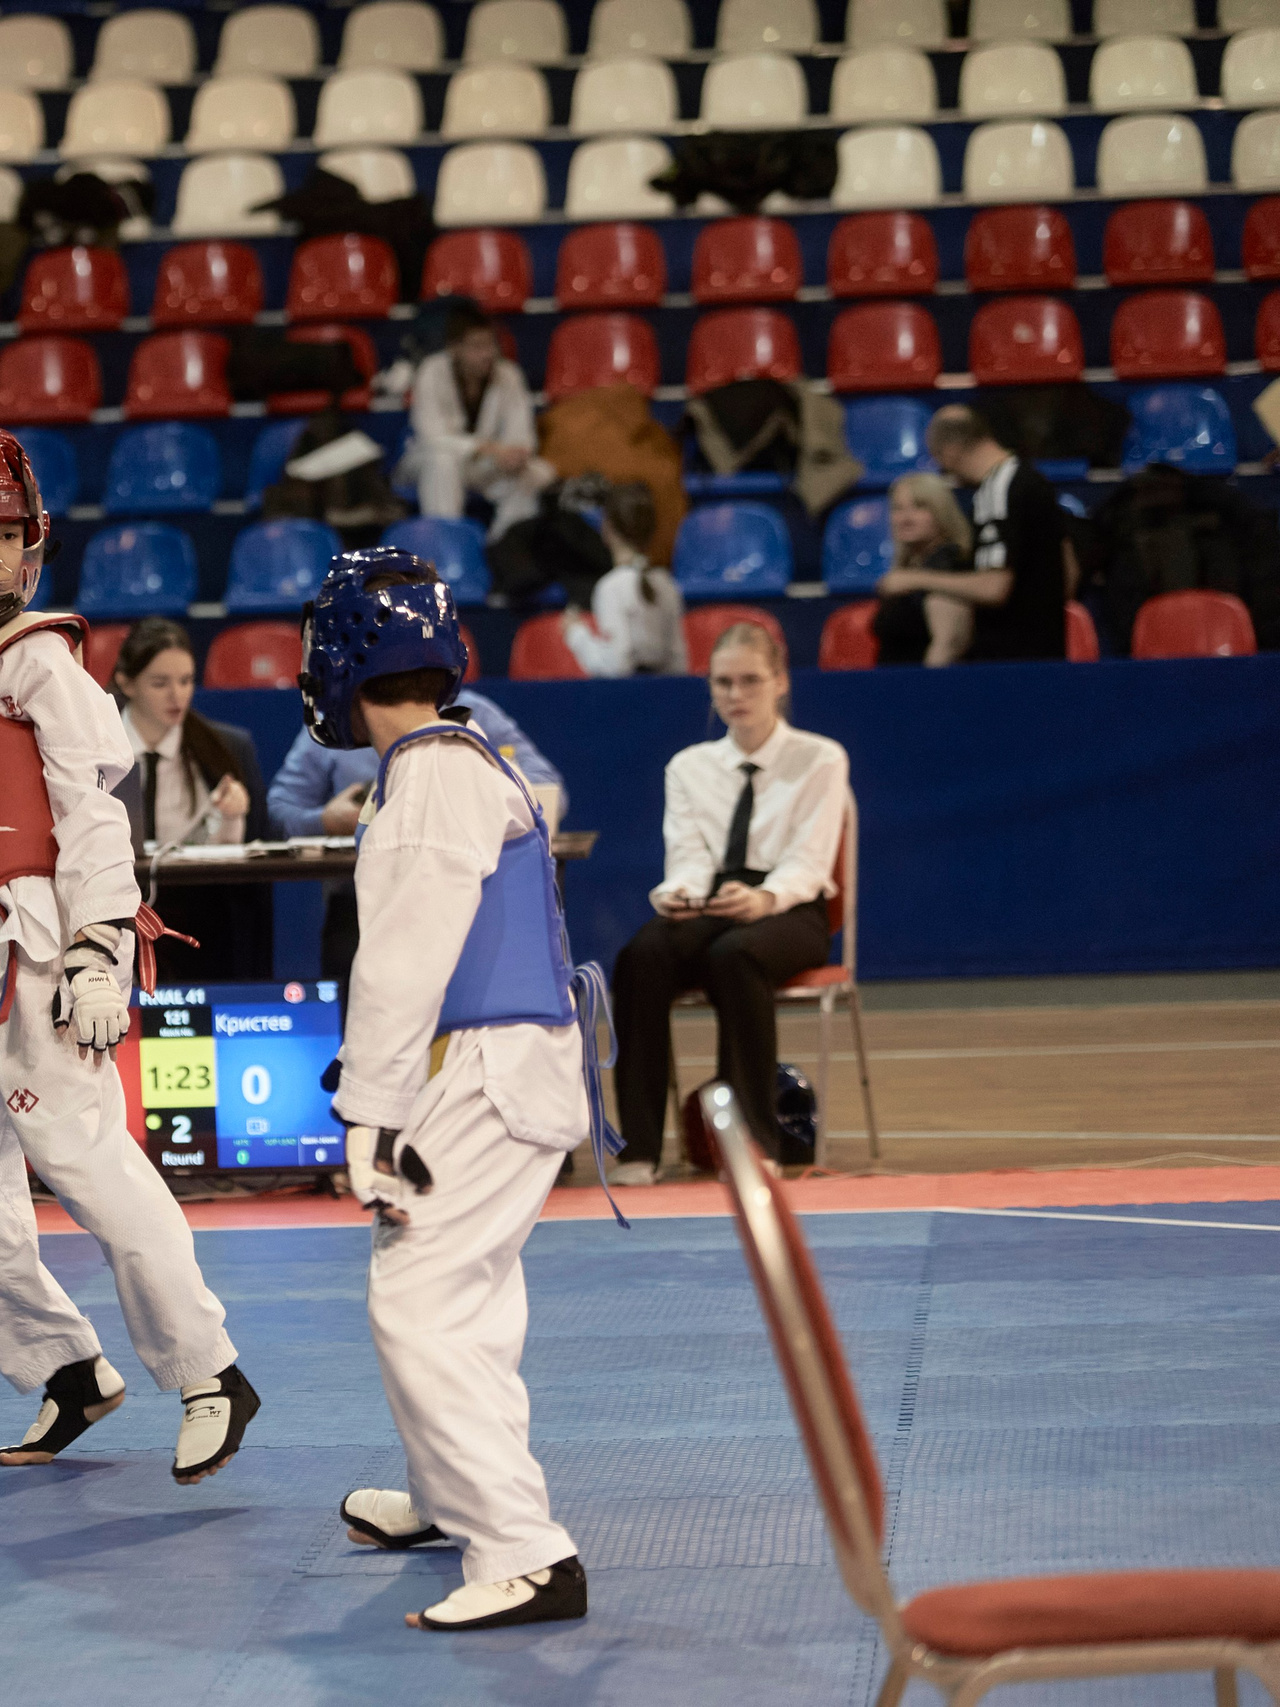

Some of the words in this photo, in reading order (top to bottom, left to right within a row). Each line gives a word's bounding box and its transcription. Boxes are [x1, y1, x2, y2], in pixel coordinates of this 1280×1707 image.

[422, 625, 434, 639] M
[185, 987, 206, 1005] 41
[163, 1009, 190, 1026] 121
[215, 1013, 293, 1036] Кристев
[148, 1065, 211, 1090] 1:23
[241, 1065, 271, 1105] 0
[171, 1115, 192, 1144] 2
[161, 1150, 205, 1166] Round
